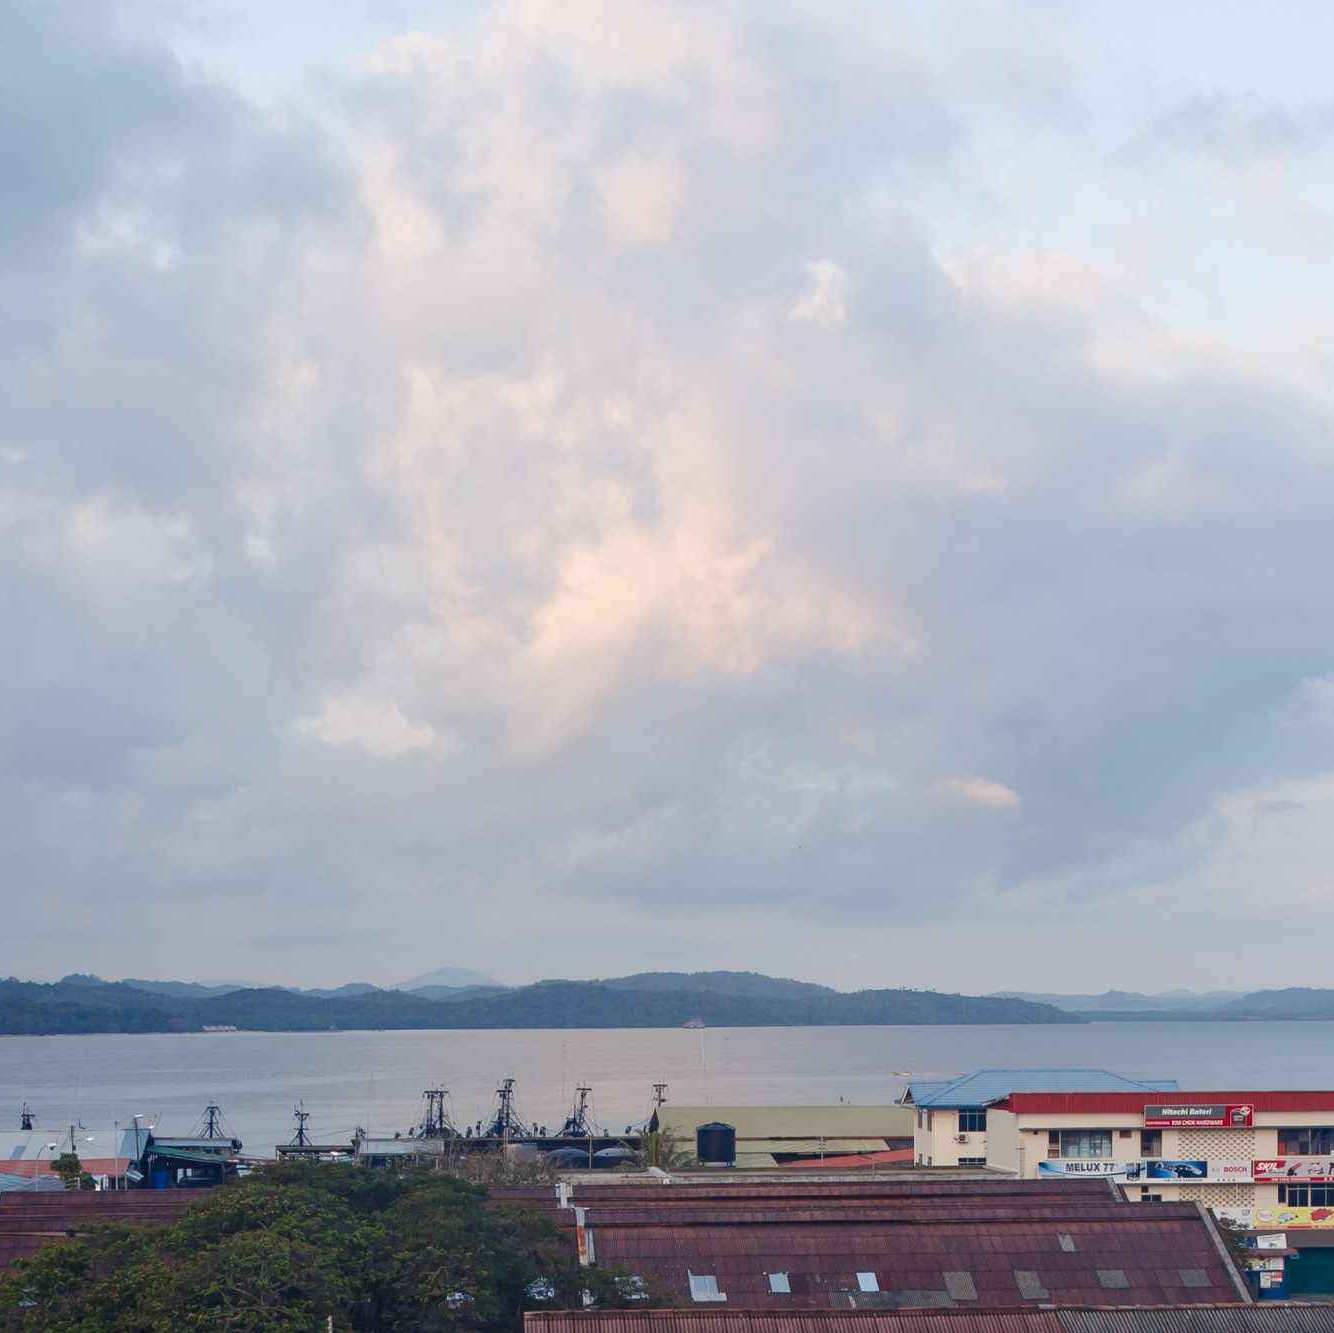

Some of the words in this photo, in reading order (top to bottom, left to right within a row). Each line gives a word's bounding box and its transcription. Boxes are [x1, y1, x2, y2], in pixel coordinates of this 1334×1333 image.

[1066, 1163, 1100, 1171] MELUX
[1103, 1163, 1115, 1171] 77
[1256, 1162, 1278, 1171] SKIL
